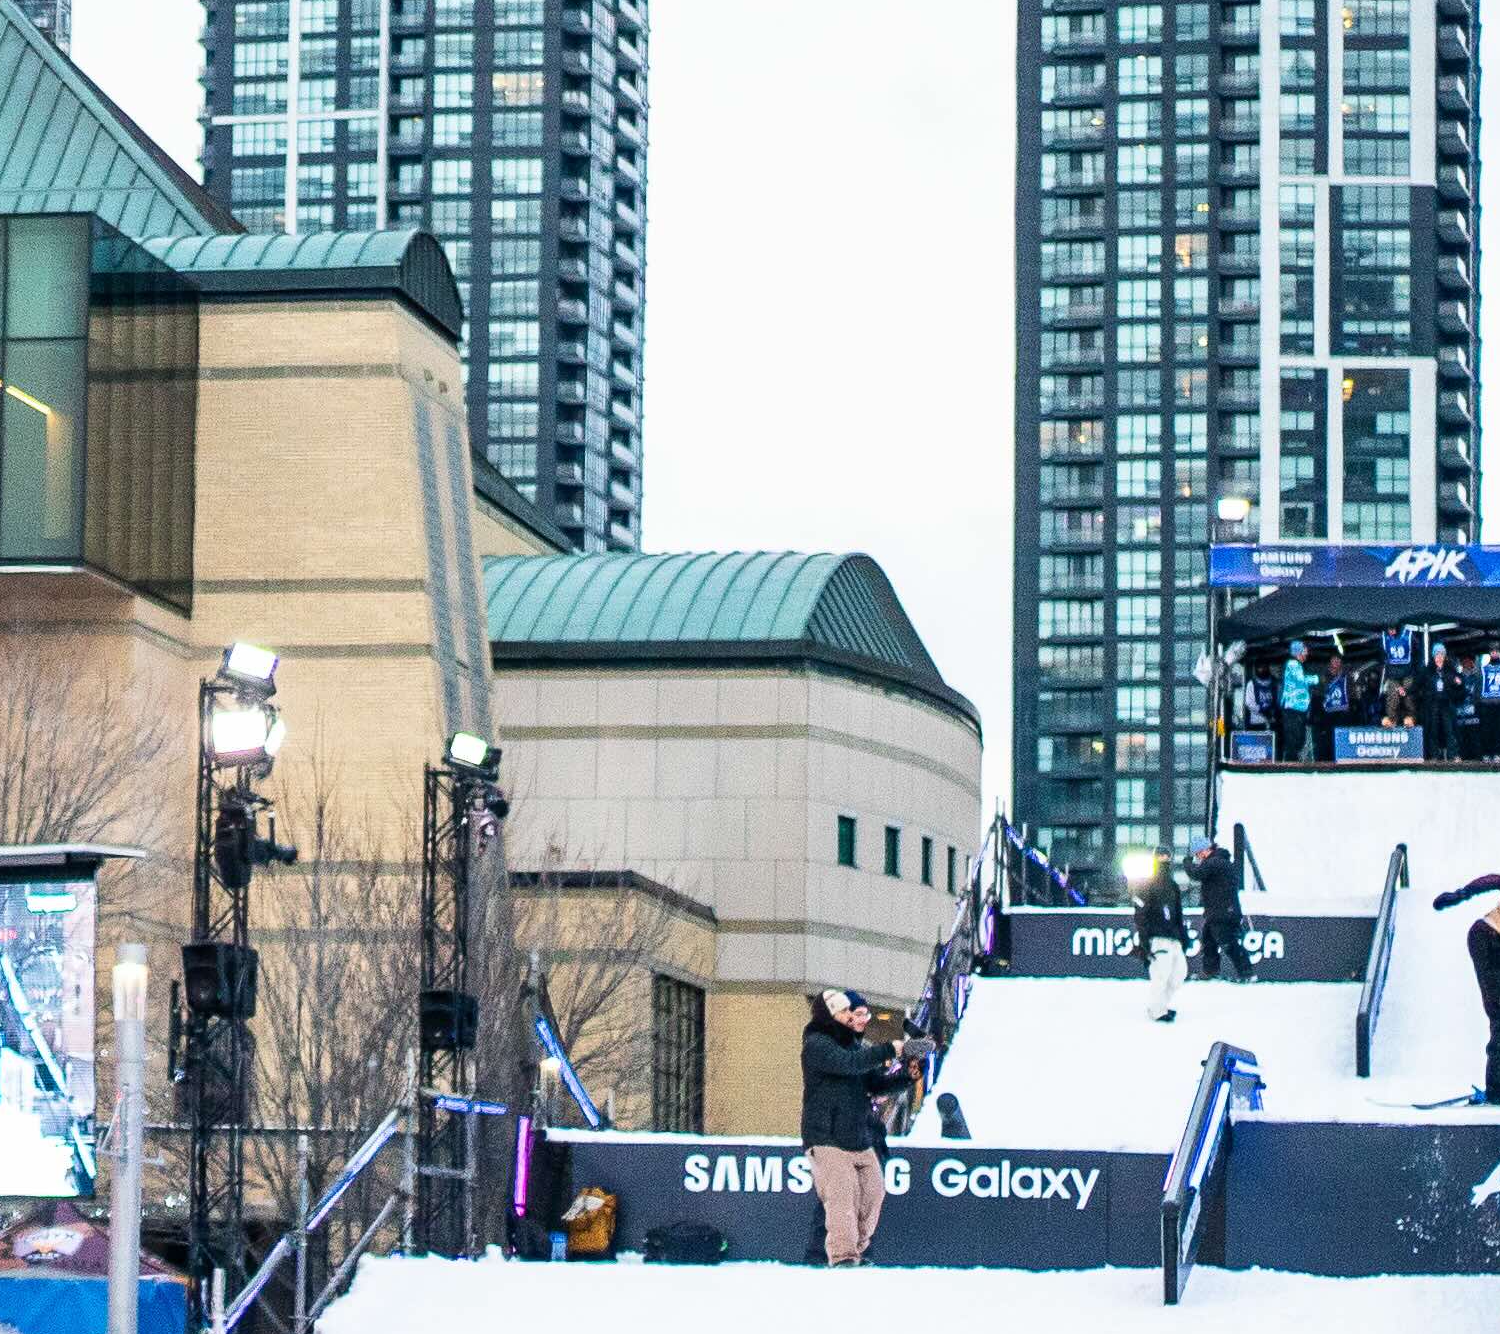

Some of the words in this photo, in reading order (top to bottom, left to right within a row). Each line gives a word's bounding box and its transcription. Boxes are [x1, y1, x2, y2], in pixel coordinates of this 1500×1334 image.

[1384, 548, 1468, 584] APIK
[1348, 731, 1409, 744] SAMSUNG
[683, 1155, 911, 1194] SAMSG
[931, 1158, 1100, 1210] Galaxy
